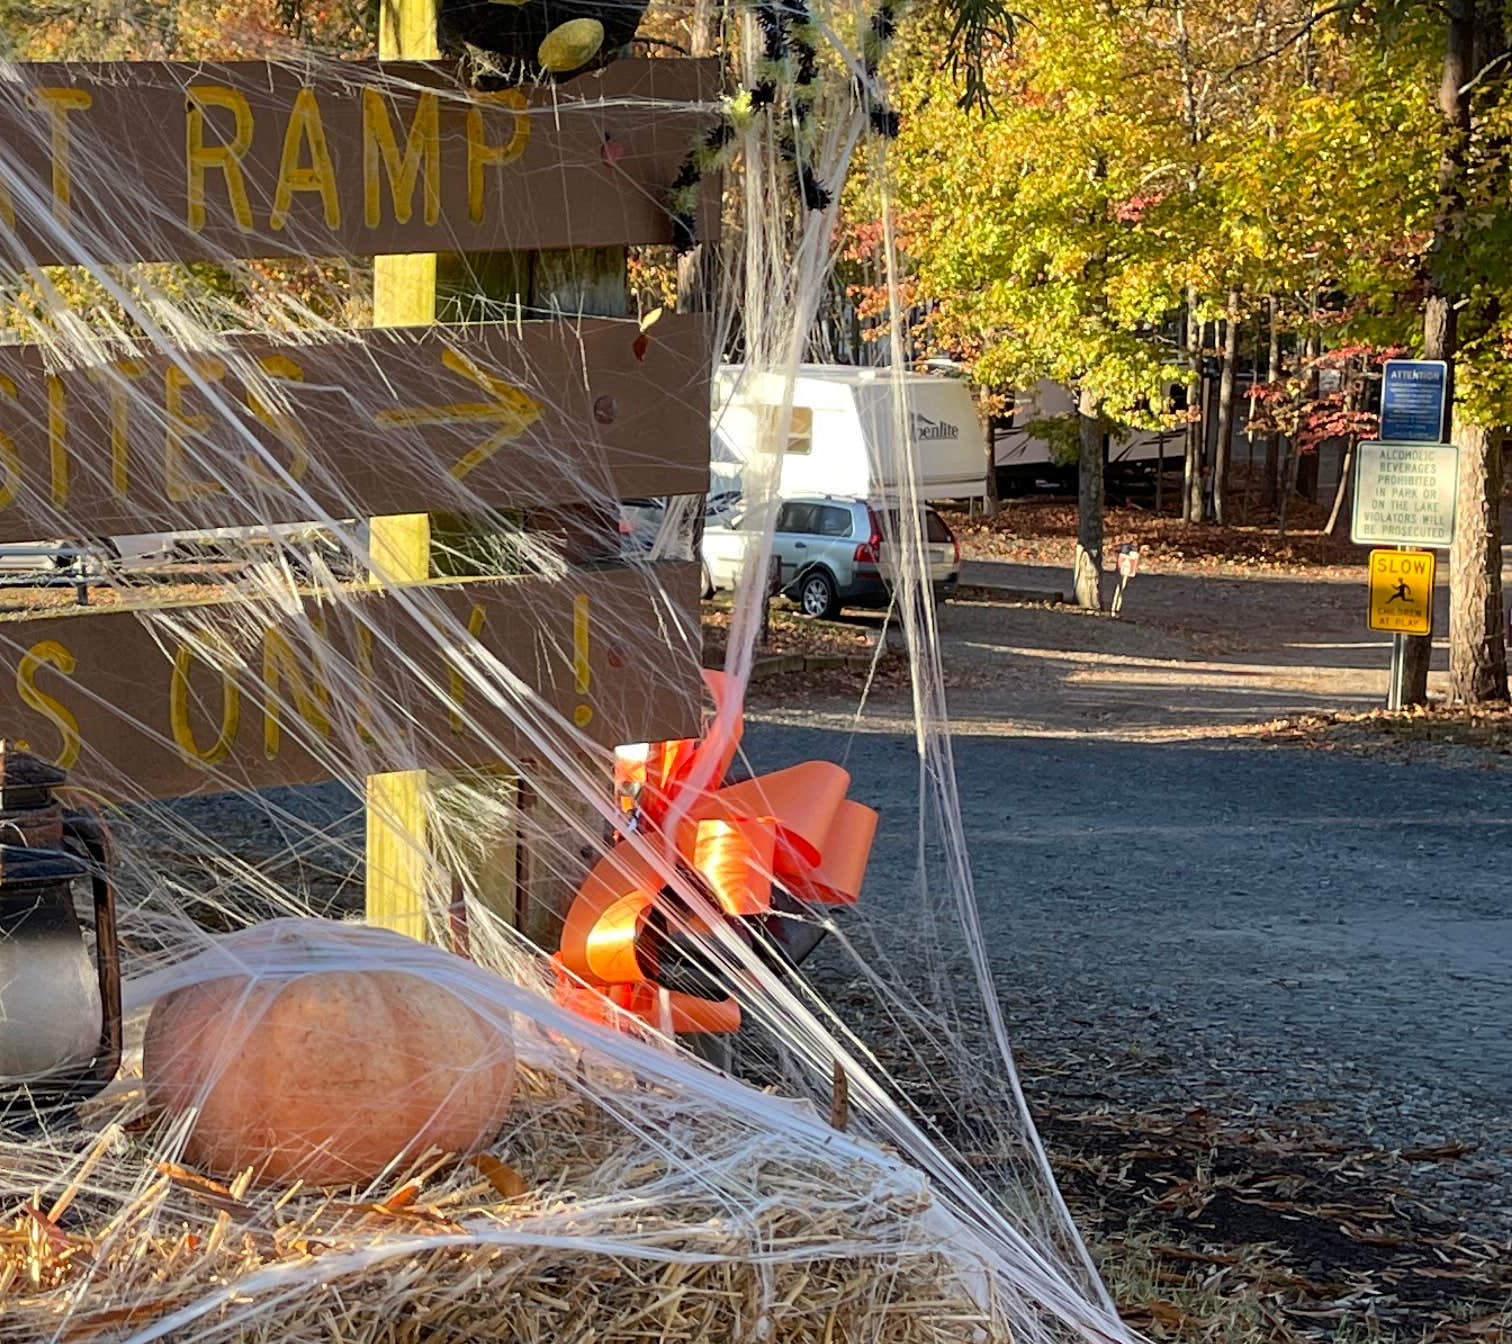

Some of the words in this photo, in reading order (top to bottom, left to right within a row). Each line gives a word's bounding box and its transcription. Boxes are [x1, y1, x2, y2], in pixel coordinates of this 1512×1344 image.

[185, 85, 531, 234] RAMP
[1390, 369, 1440, 381] ATTENTION
[1379, 450, 1435, 461] ALCOHOLIC
[1379, 462, 1437, 474] BEVERAGES
[1378, 475, 1436, 487] PROHIBITED
[1376, 487, 1386, 497] IN
[1392, 488, 1418, 499] PARK
[1423, 489, 1437, 499] OR
[1371, 500, 1385, 510] ON
[1391, 500, 1409, 511] THE
[1414, 502, 1440, 513] LAKE
[1364, 512, 1417, 524] VIOLATORS
[1422, 515, 1446, 526] WILL
[1364, 524, 1377, 535] BE
[1382, 525, 1445, 537] PROSECUTED
[1377, 558, 1426, 575] SLOW
